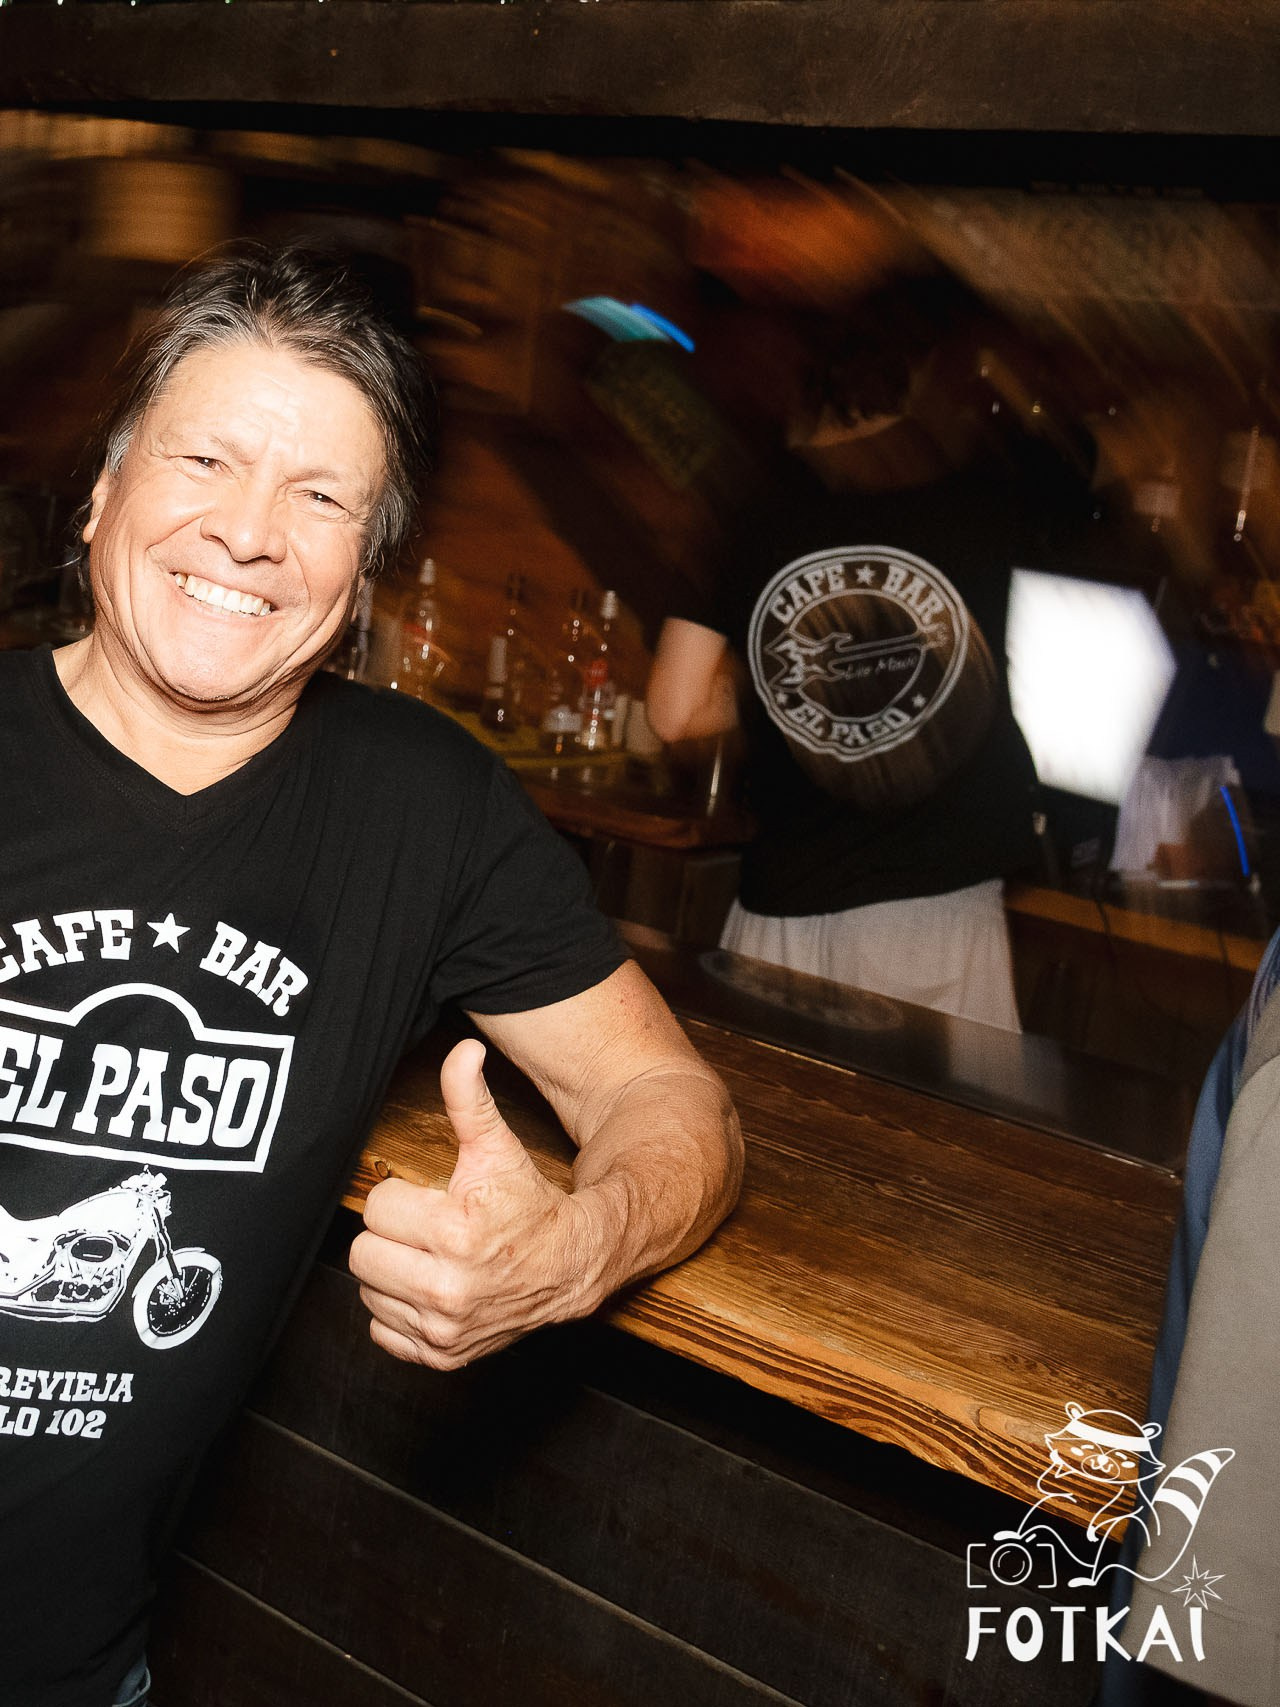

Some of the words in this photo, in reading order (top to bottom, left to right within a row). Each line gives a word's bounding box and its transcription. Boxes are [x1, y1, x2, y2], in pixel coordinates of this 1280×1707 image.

[768, 563, 846, 625] CAFE
[882, 563, 946, 626] BAR
[783, 702, 825, 738] EL
[829, 706, 911, 746] PASO
[198, 920, 310, 1017] BAR
[71, 1043, 271, 1149] PASO
[44, 1408, 107, 1439] 102
